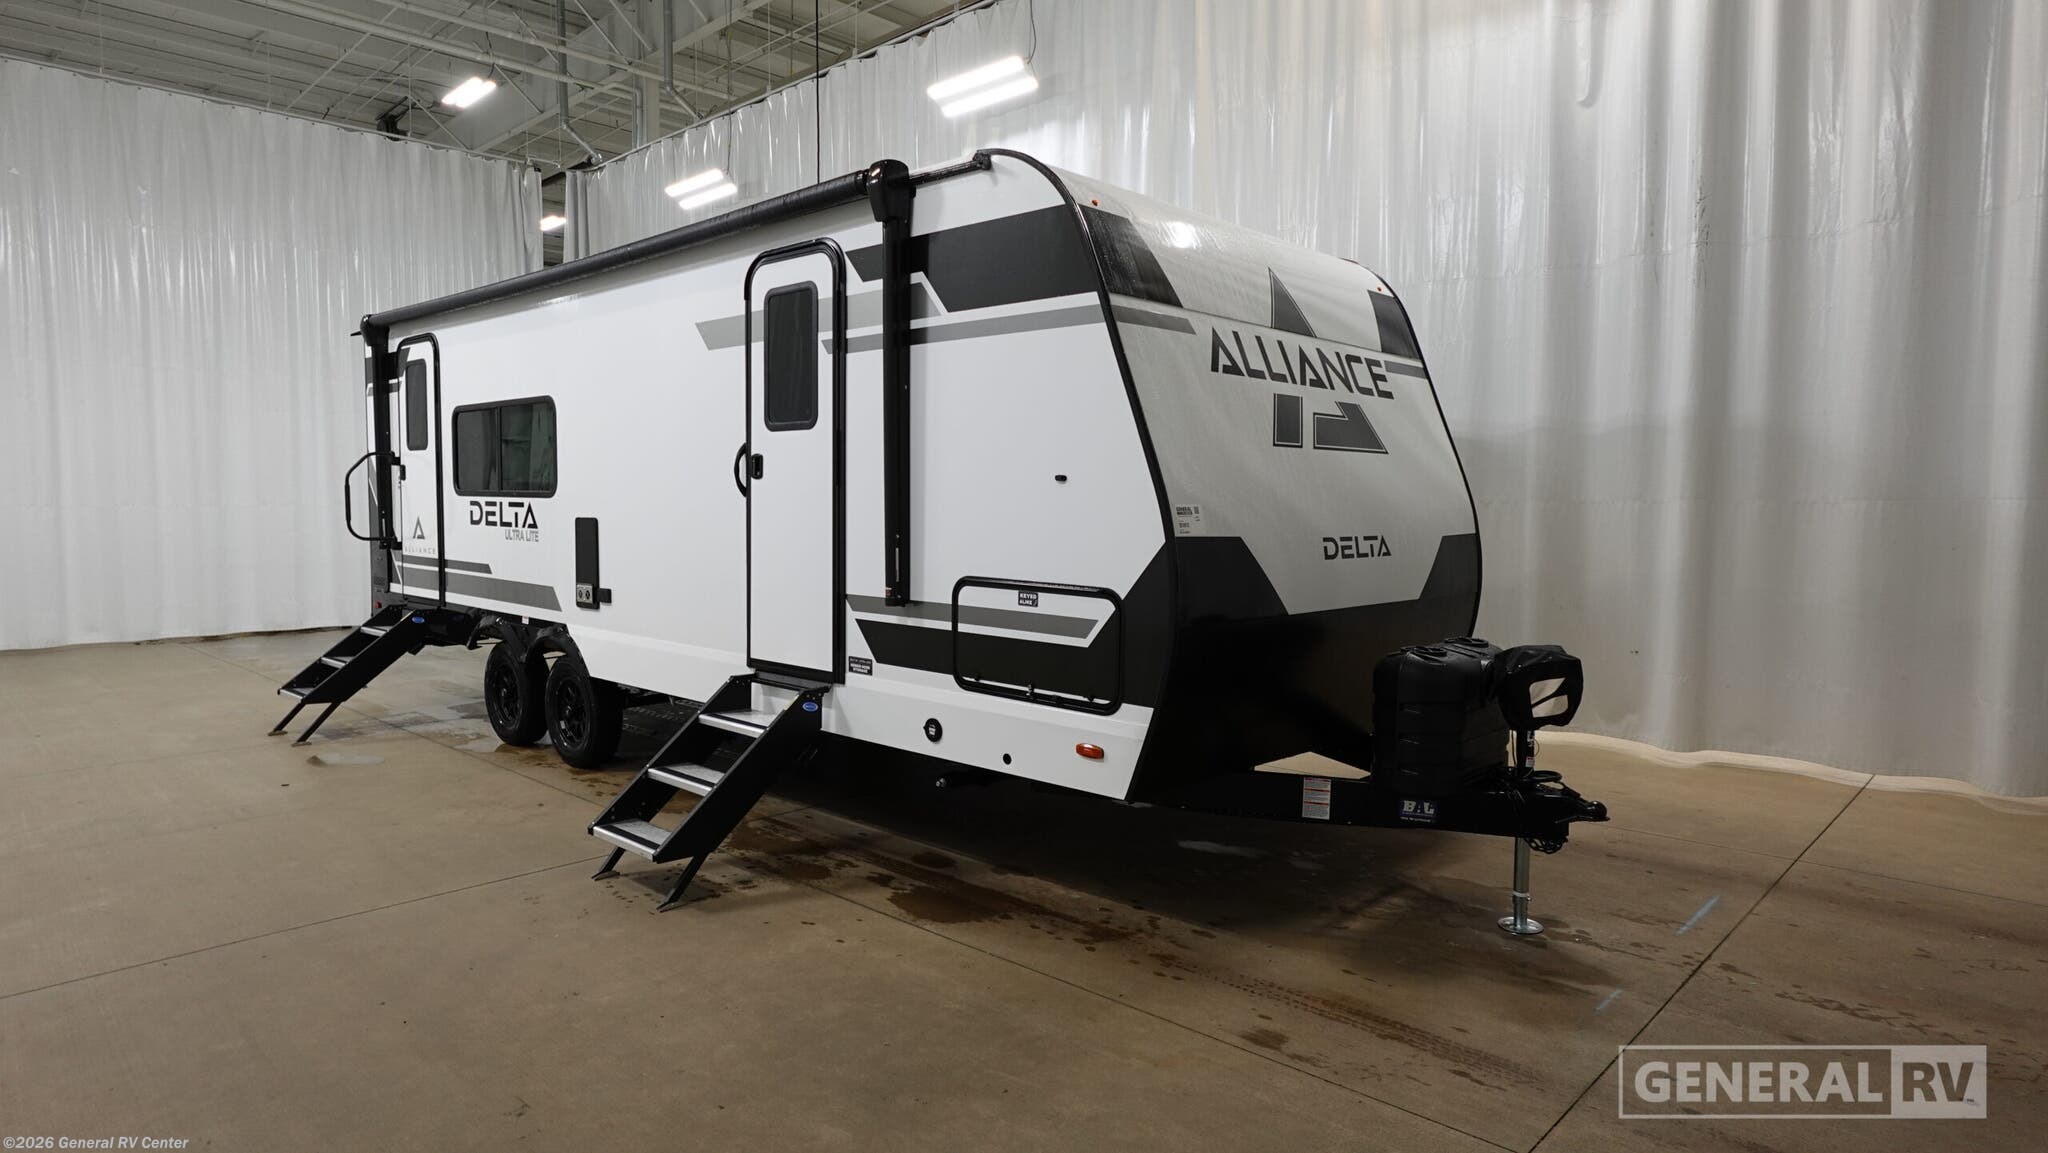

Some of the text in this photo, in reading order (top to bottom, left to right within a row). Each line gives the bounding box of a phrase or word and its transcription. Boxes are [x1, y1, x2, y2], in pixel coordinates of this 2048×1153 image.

[1210, 326, 1395, 400] ALLIANCE
[469, 500, 538, 529] DELTA
[505, 529, 540, 543] ULTRA LITE
[1322, 534, 1392, 561] DELTA
